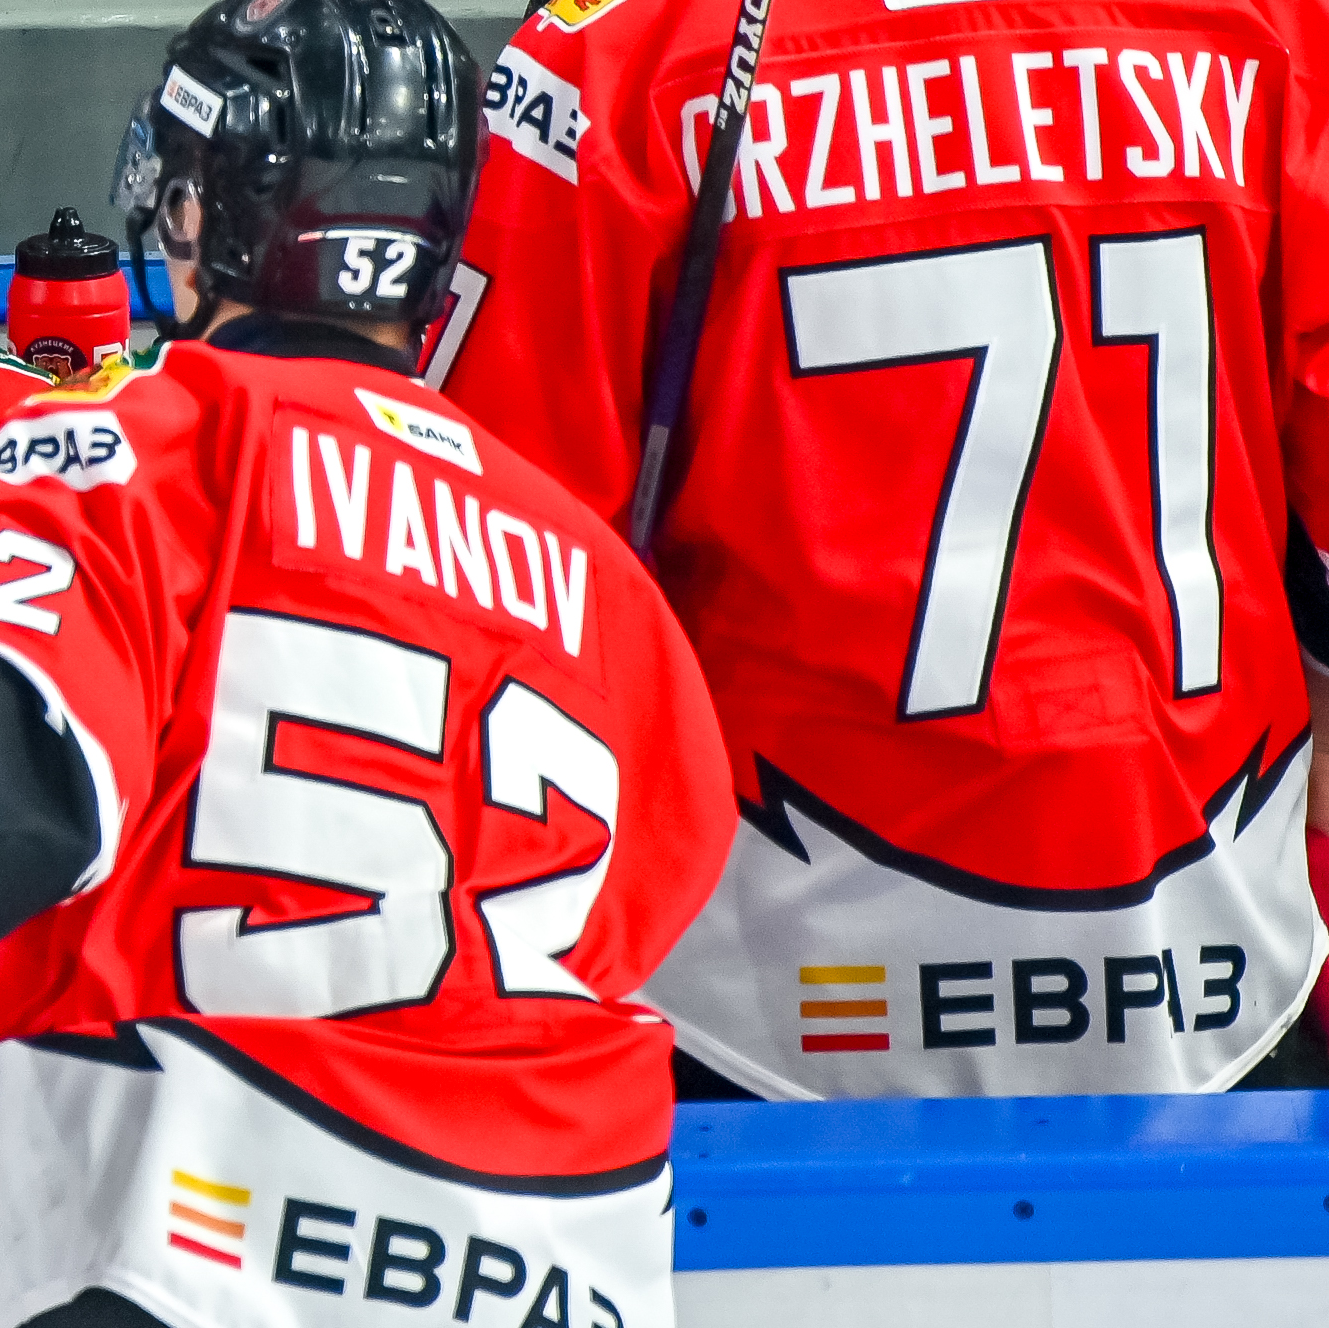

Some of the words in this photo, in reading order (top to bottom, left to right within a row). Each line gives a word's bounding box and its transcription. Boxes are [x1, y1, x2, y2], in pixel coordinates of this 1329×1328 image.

[174, 84, 214, 123] ЕВРАЗ
[337, 238, 417, 299] 52
[292, 426, 588, 658] IVANOV
[781, 225, 1224, 722] 71
[172, 606, 622, 1019] 52
